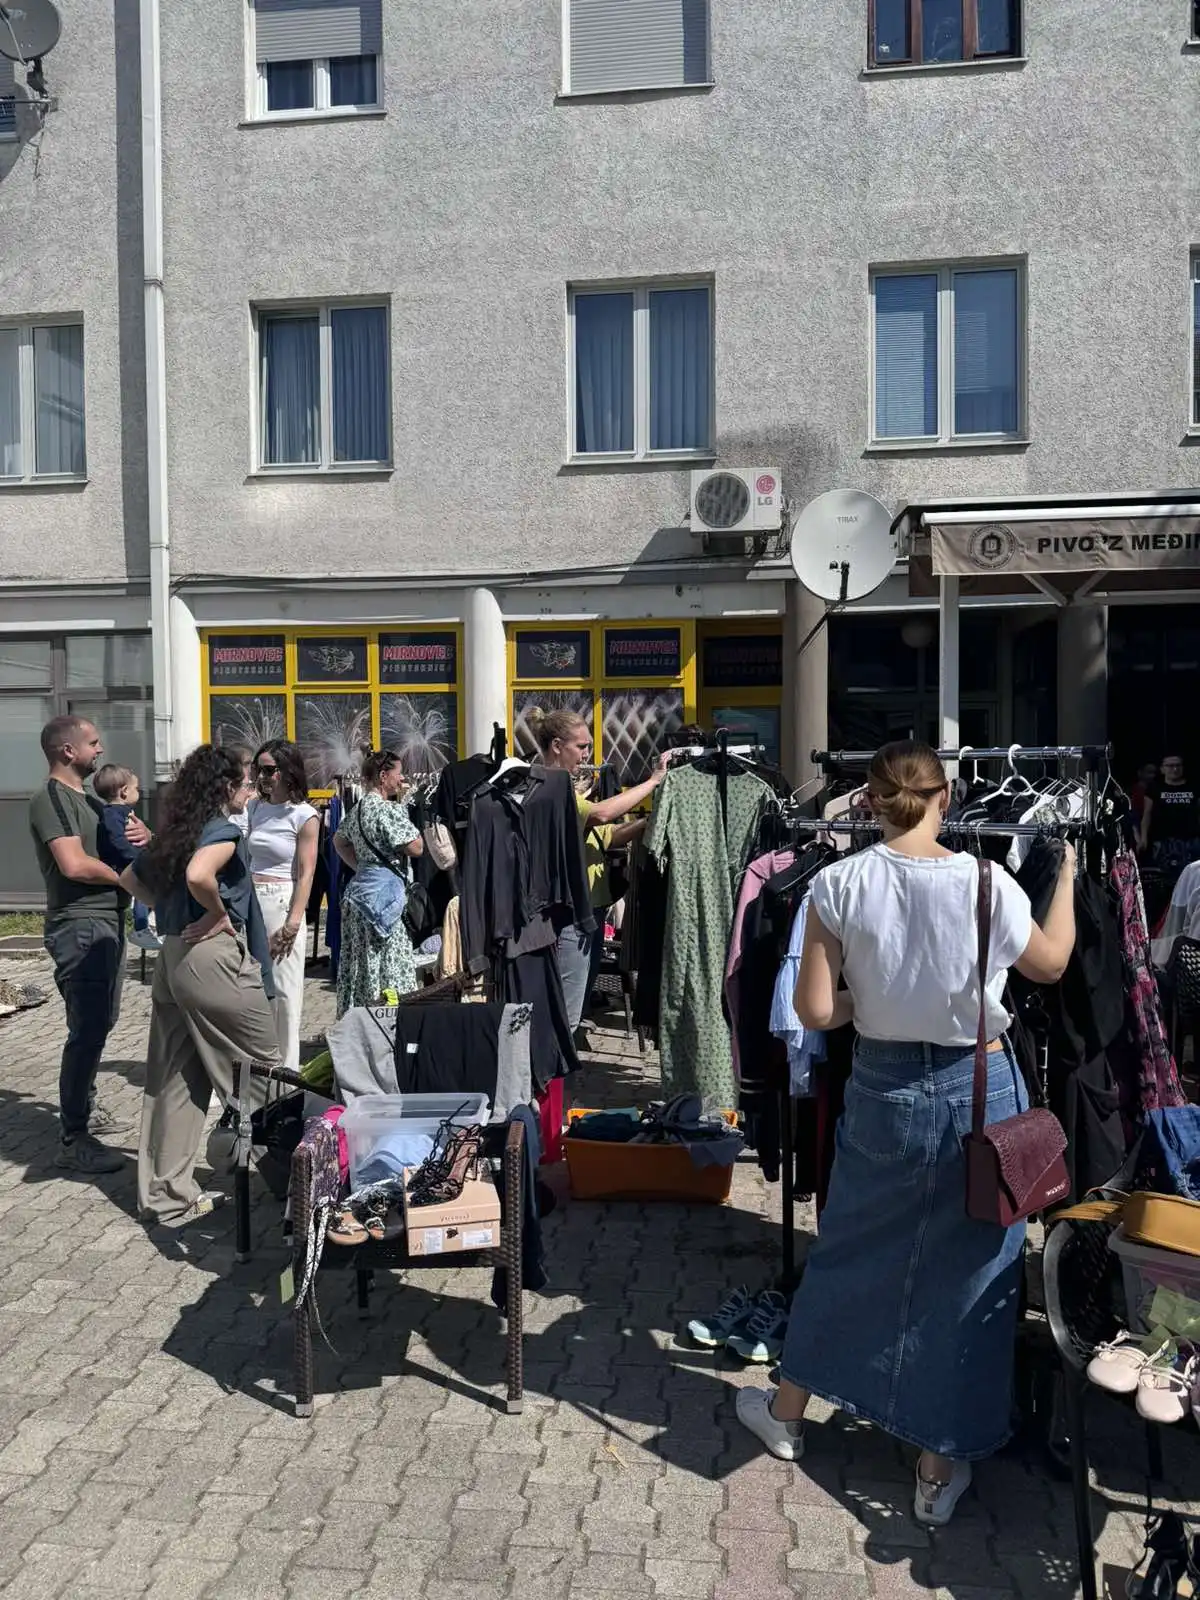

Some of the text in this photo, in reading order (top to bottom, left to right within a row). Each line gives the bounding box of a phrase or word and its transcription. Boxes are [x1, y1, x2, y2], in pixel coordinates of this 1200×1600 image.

[757, 497, 773, 506] LG
[1037, 536, 1095, 553] PIVO
[214, 647, 283, 663] MIRNOVEC
[383, 645, 454, 661] MIRNOVEC
